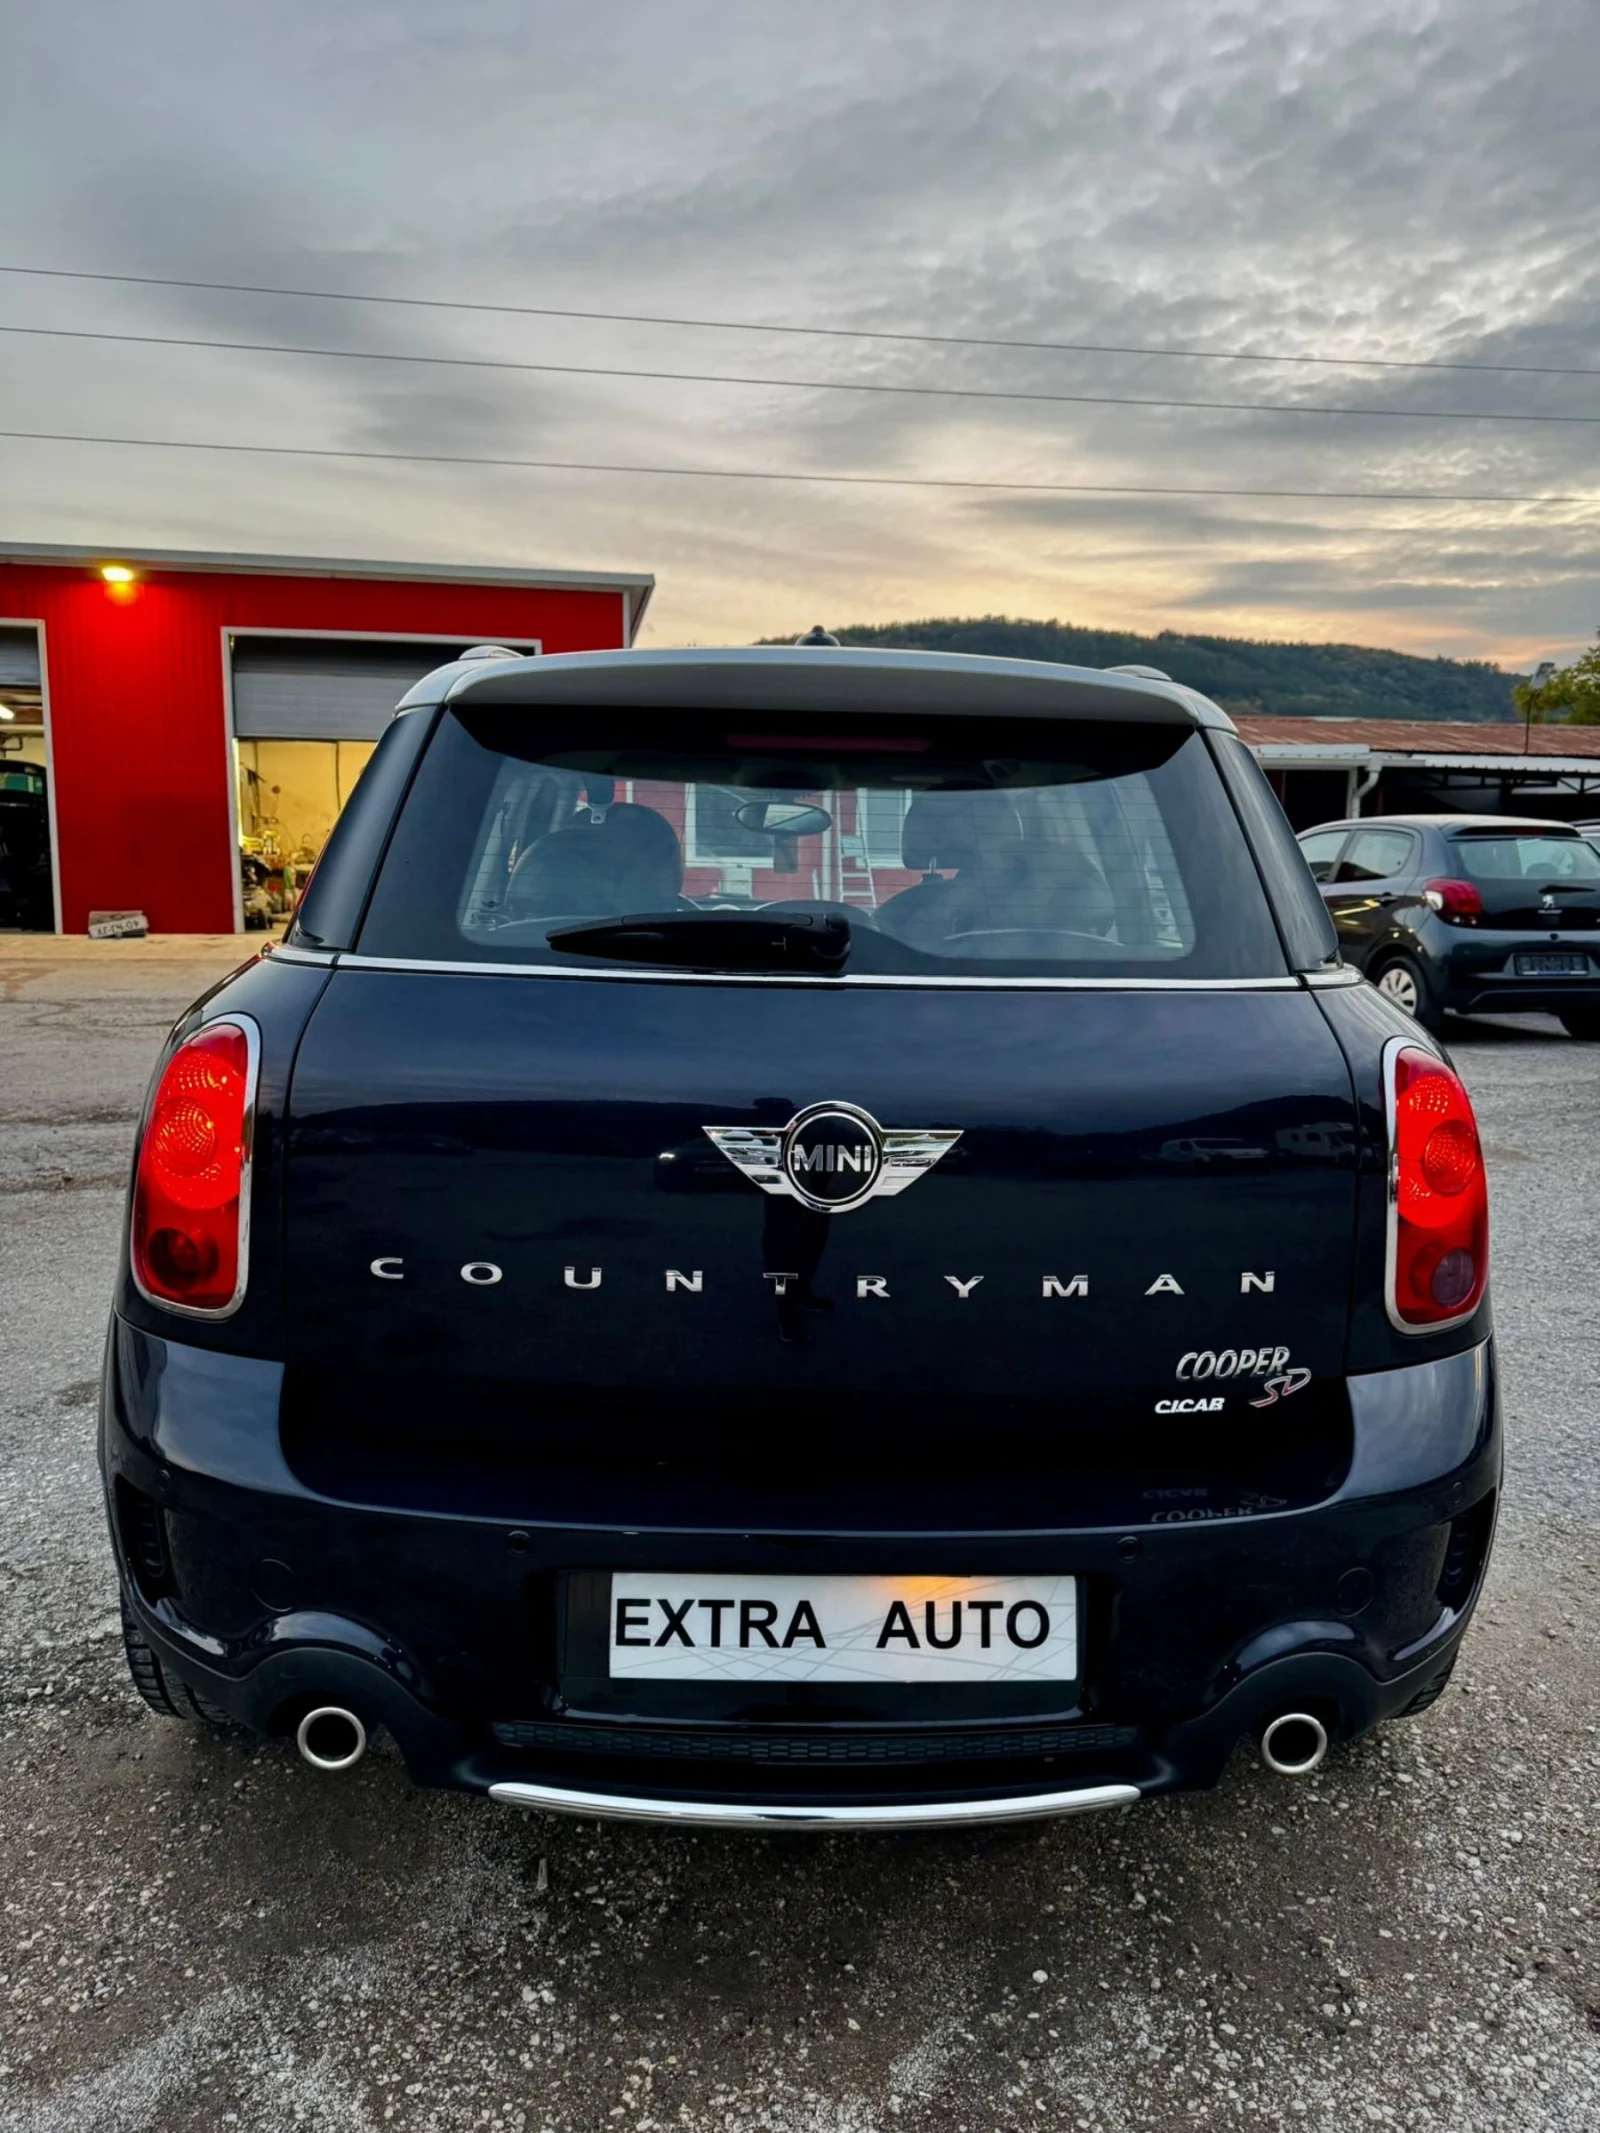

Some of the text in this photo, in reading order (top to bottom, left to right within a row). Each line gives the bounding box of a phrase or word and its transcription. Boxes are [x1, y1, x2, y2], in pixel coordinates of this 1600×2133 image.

[793, 1144, 872, 1172] MINI
[370, 1257, 1276, 1298] COUNTRYMAN
[1175, 1346, 1290, 1381] COOPER
[1249, 1368, 1312, 1408] SD
[613, 1598, 1050, 1649] EXTRA AUTO
